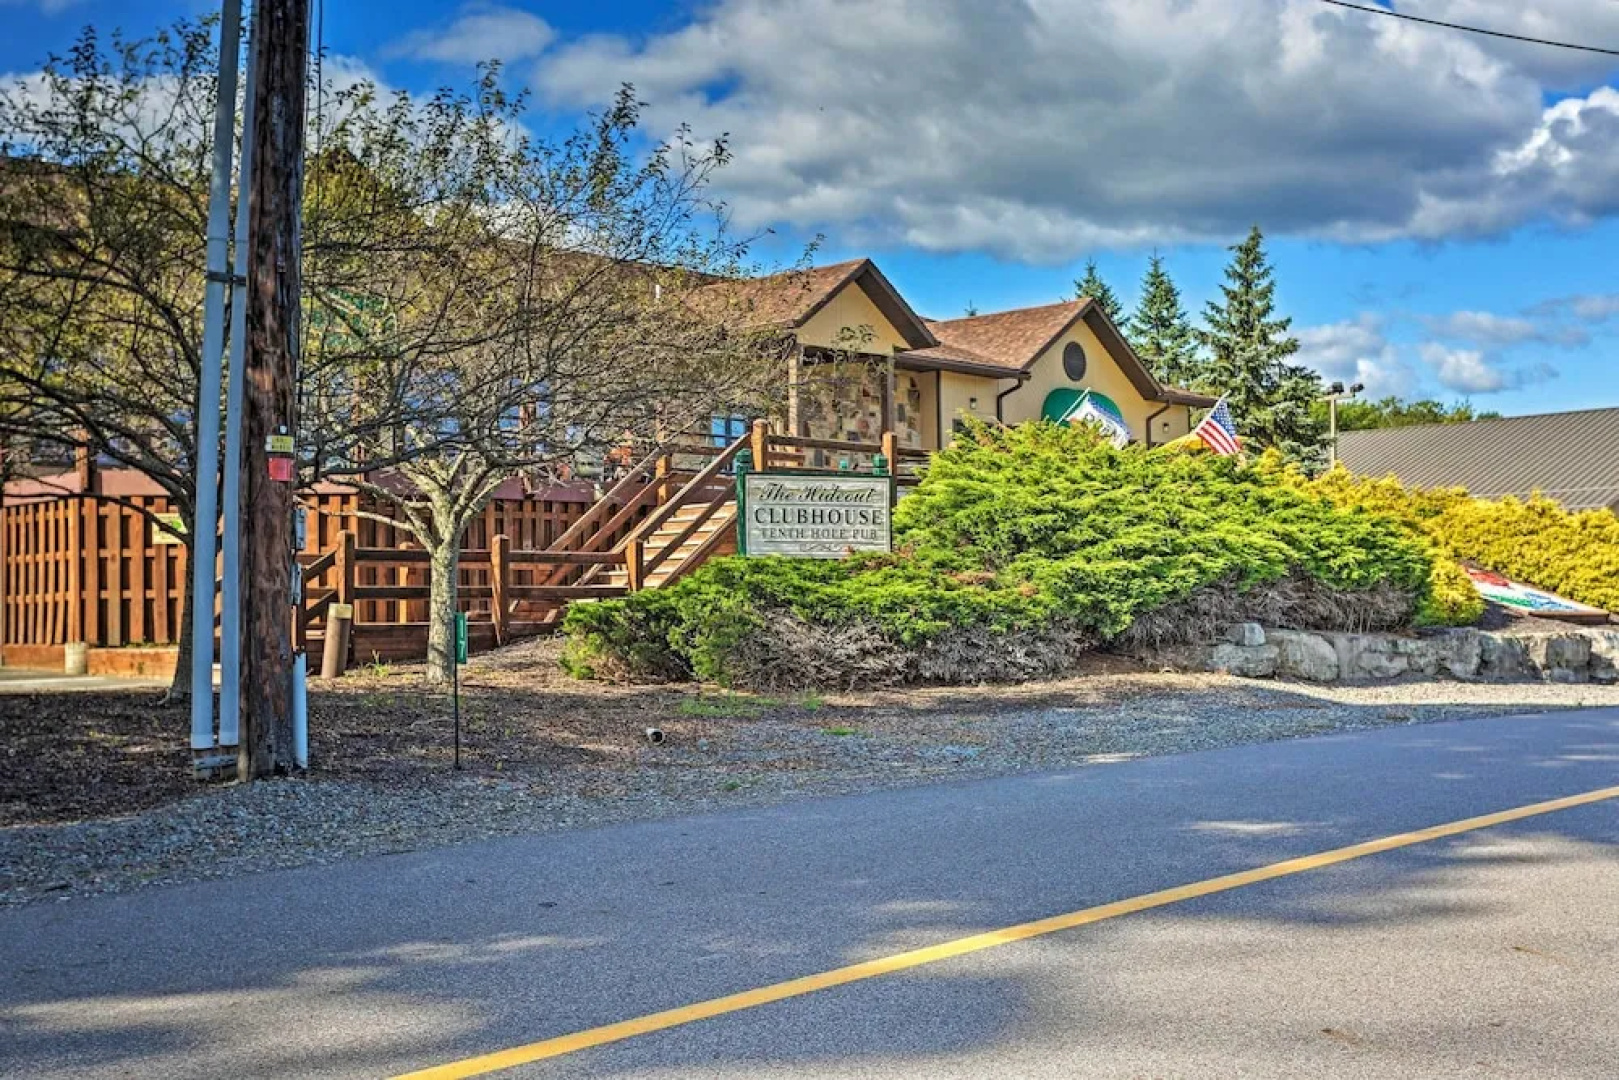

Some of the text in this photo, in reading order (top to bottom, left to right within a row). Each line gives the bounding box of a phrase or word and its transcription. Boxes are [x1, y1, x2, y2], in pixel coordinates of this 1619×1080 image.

[759, 482, 876, 503] The Hideout
[755, 508, 883, 525] CLUBHOUSE
[761, 527, 877, 540] TENTH HOLE PUB
